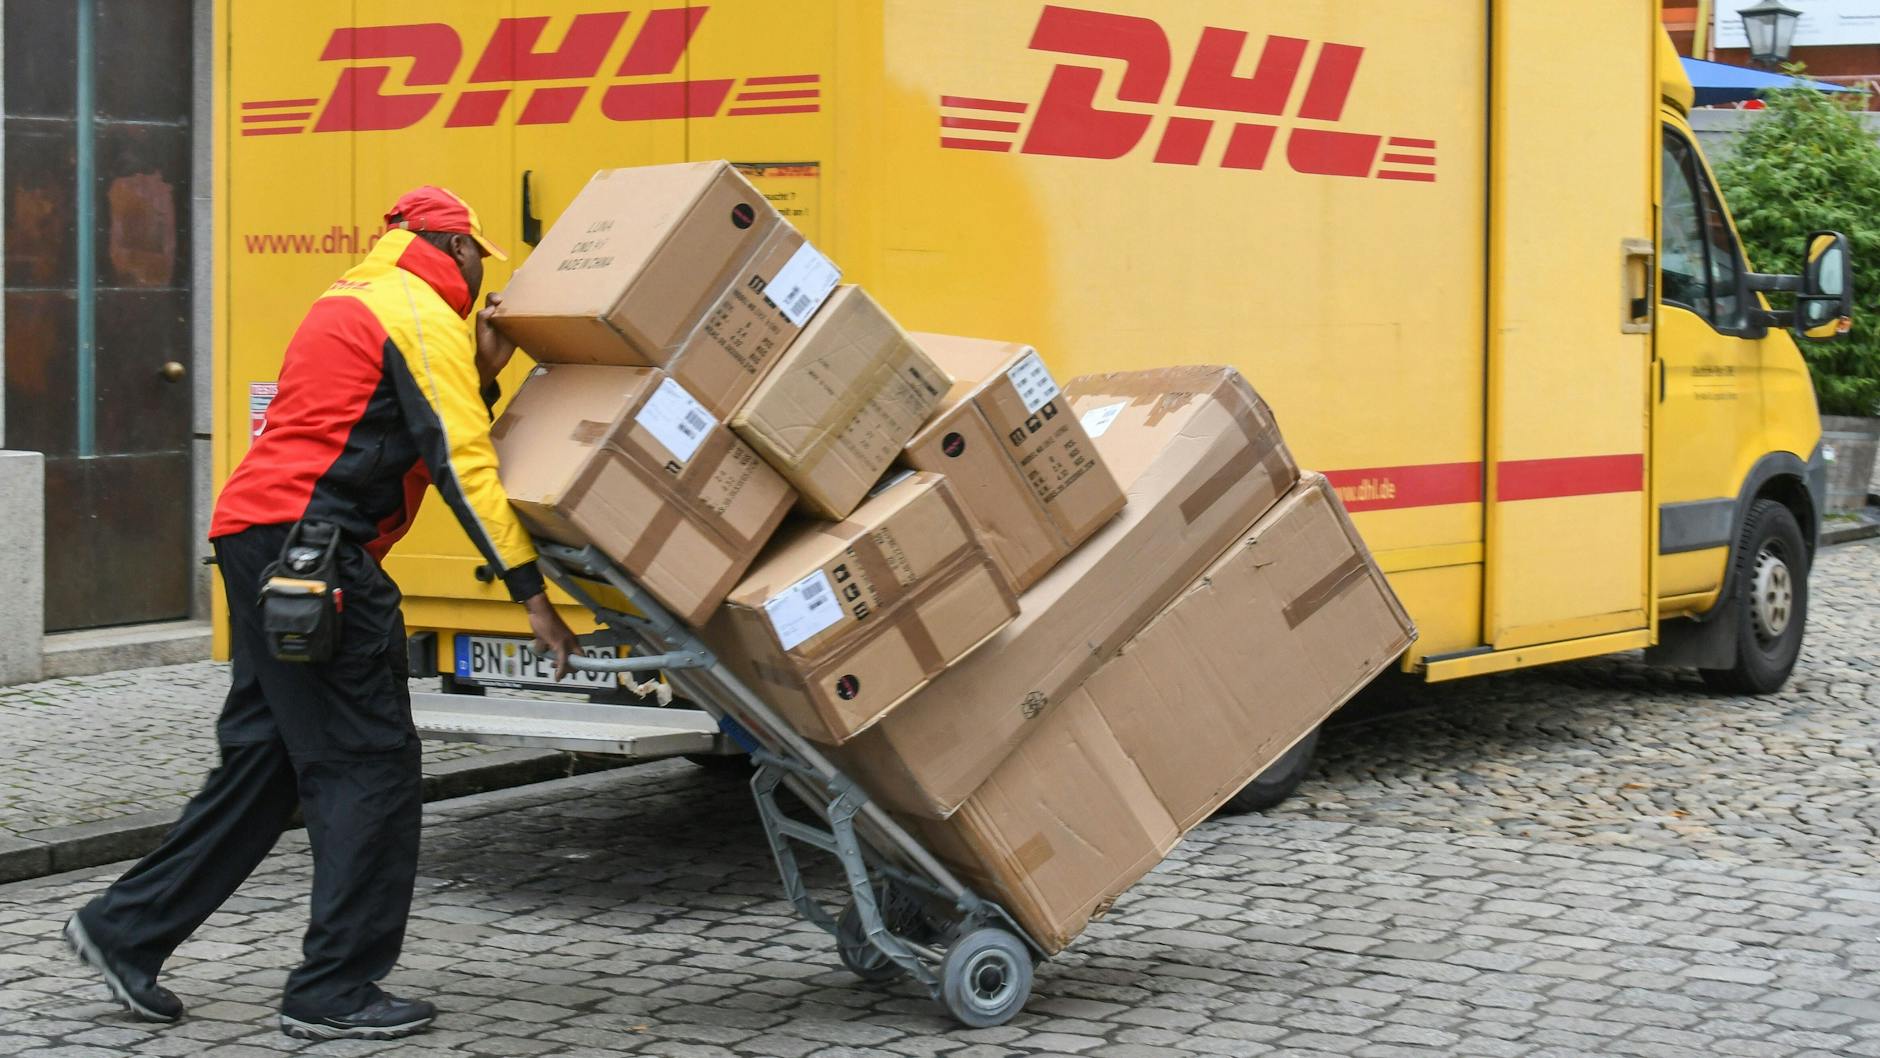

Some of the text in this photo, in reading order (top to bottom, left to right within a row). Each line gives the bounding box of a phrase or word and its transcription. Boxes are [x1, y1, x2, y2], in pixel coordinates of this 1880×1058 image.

[312, 6, 736, 133] DHL
[1020, 4, 1382, 178] DHL
[245, 226, 382, 254] www.dhl.d
[472, 641, 501, 673] BN
